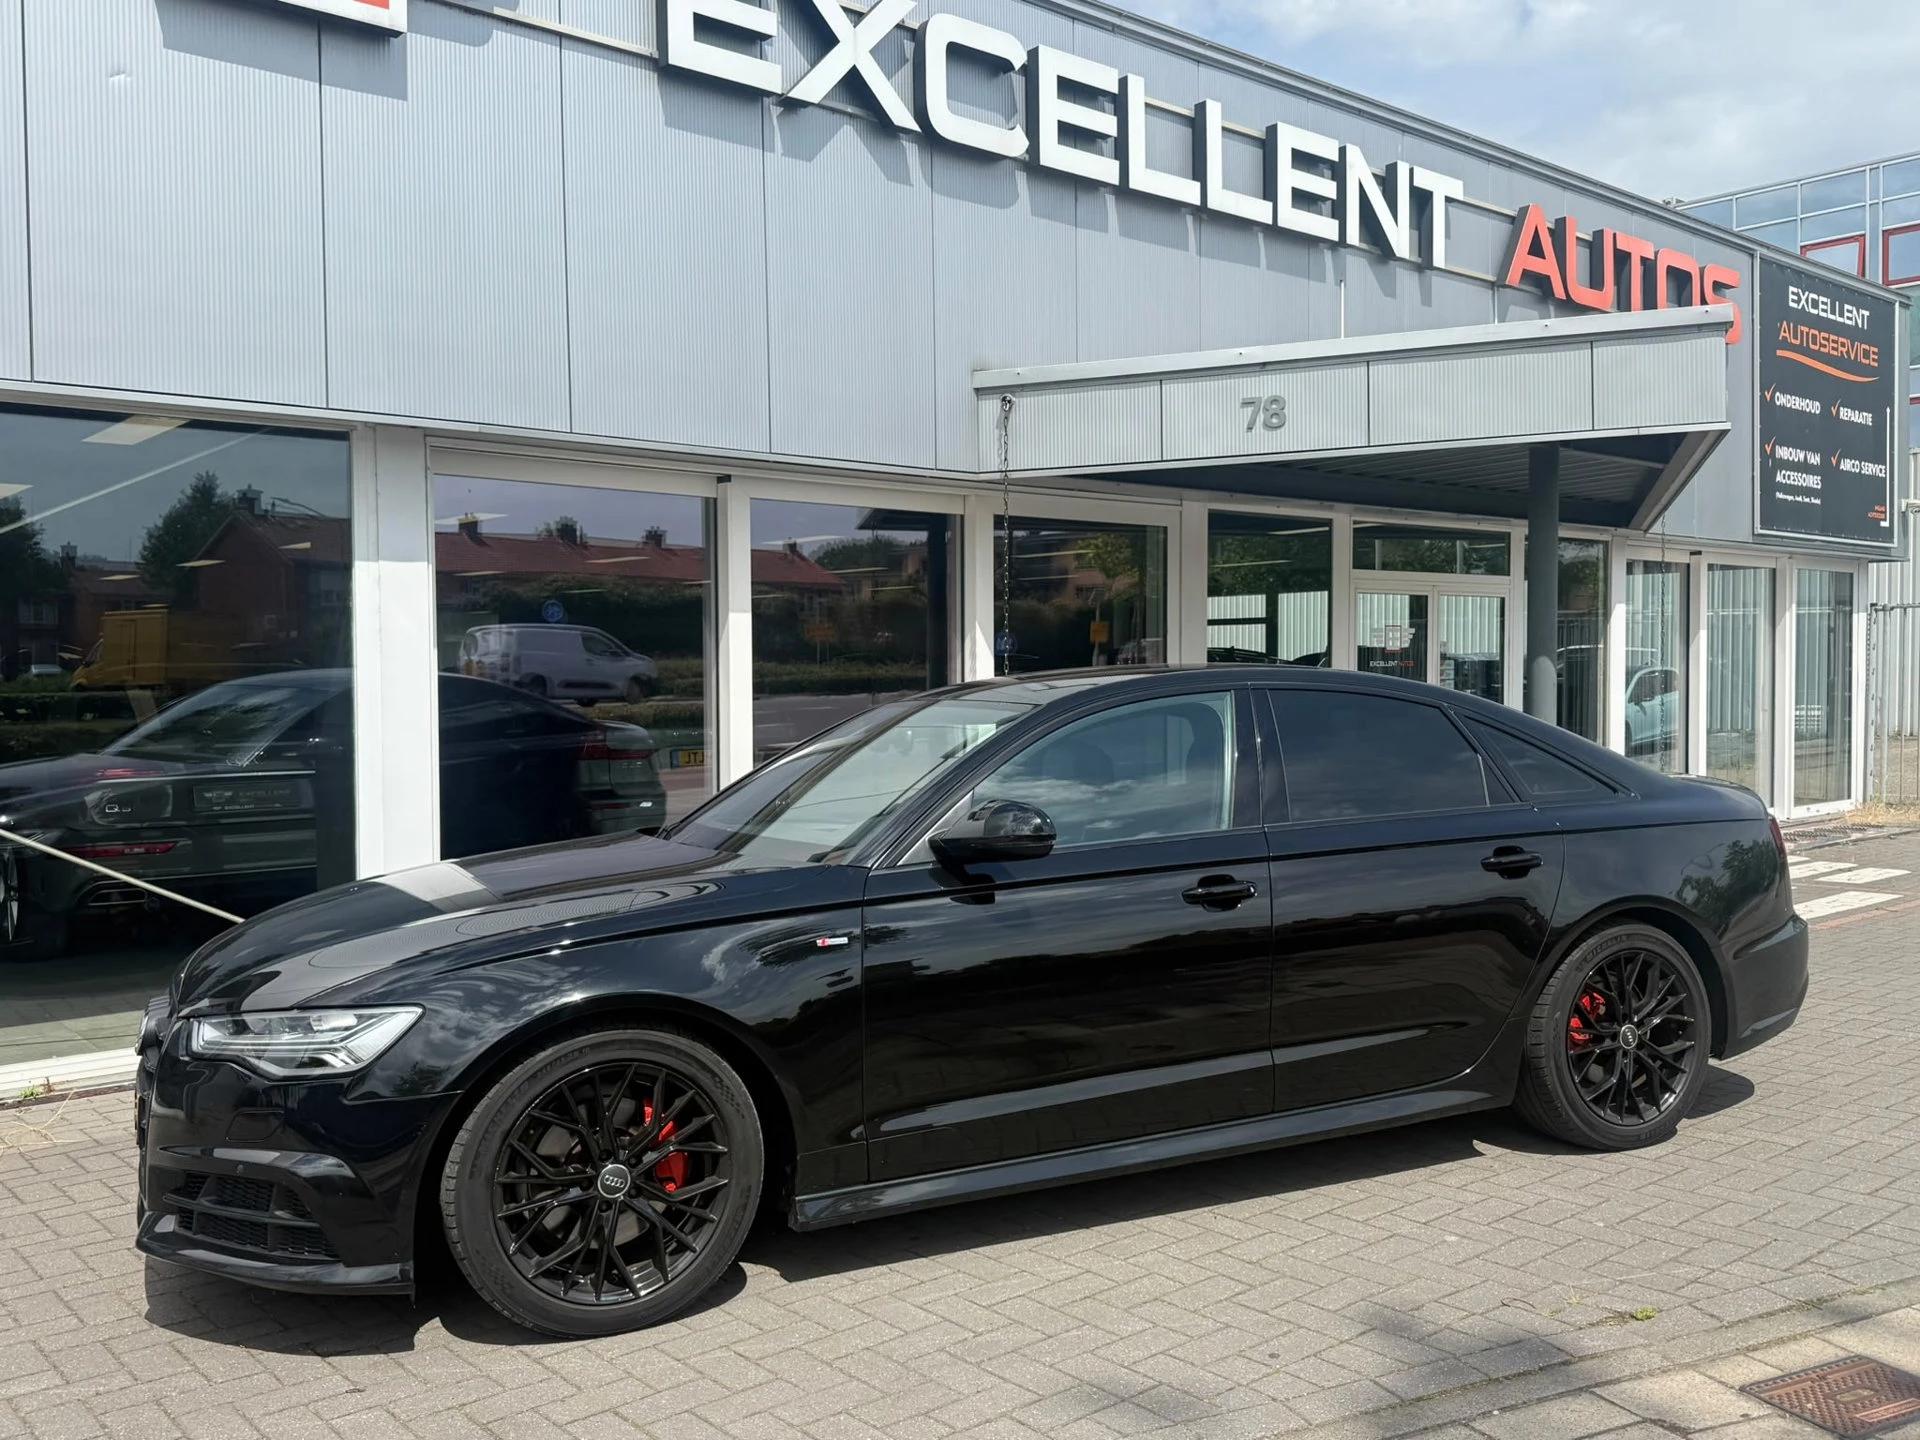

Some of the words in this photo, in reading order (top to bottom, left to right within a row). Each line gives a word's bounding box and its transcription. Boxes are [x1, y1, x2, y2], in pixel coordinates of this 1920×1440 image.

[662, 0, 1464, 269] EXCELLENT
[1506, 203, 1743, 344] AUTOS
[1788, 285, 1870, 330] EXCELLENT
[1778, 320, 1879, 367] AUTOSERVICE
[1240, 395, 1287, 432] 78
[1774, 391, 1821, 415] ONDERHOUD
[1839, 406, 1873, 426] REPARATIE
[1775, 445, 1805, 463] INBOUW
[1806, 450, 1821, 466] VAN
[1839, 457, 1860, 473] AIRCO
[1861, 459, 1886, 478] SERVICE
[1775, 469, 1822, 489] ACCESSOIRES
